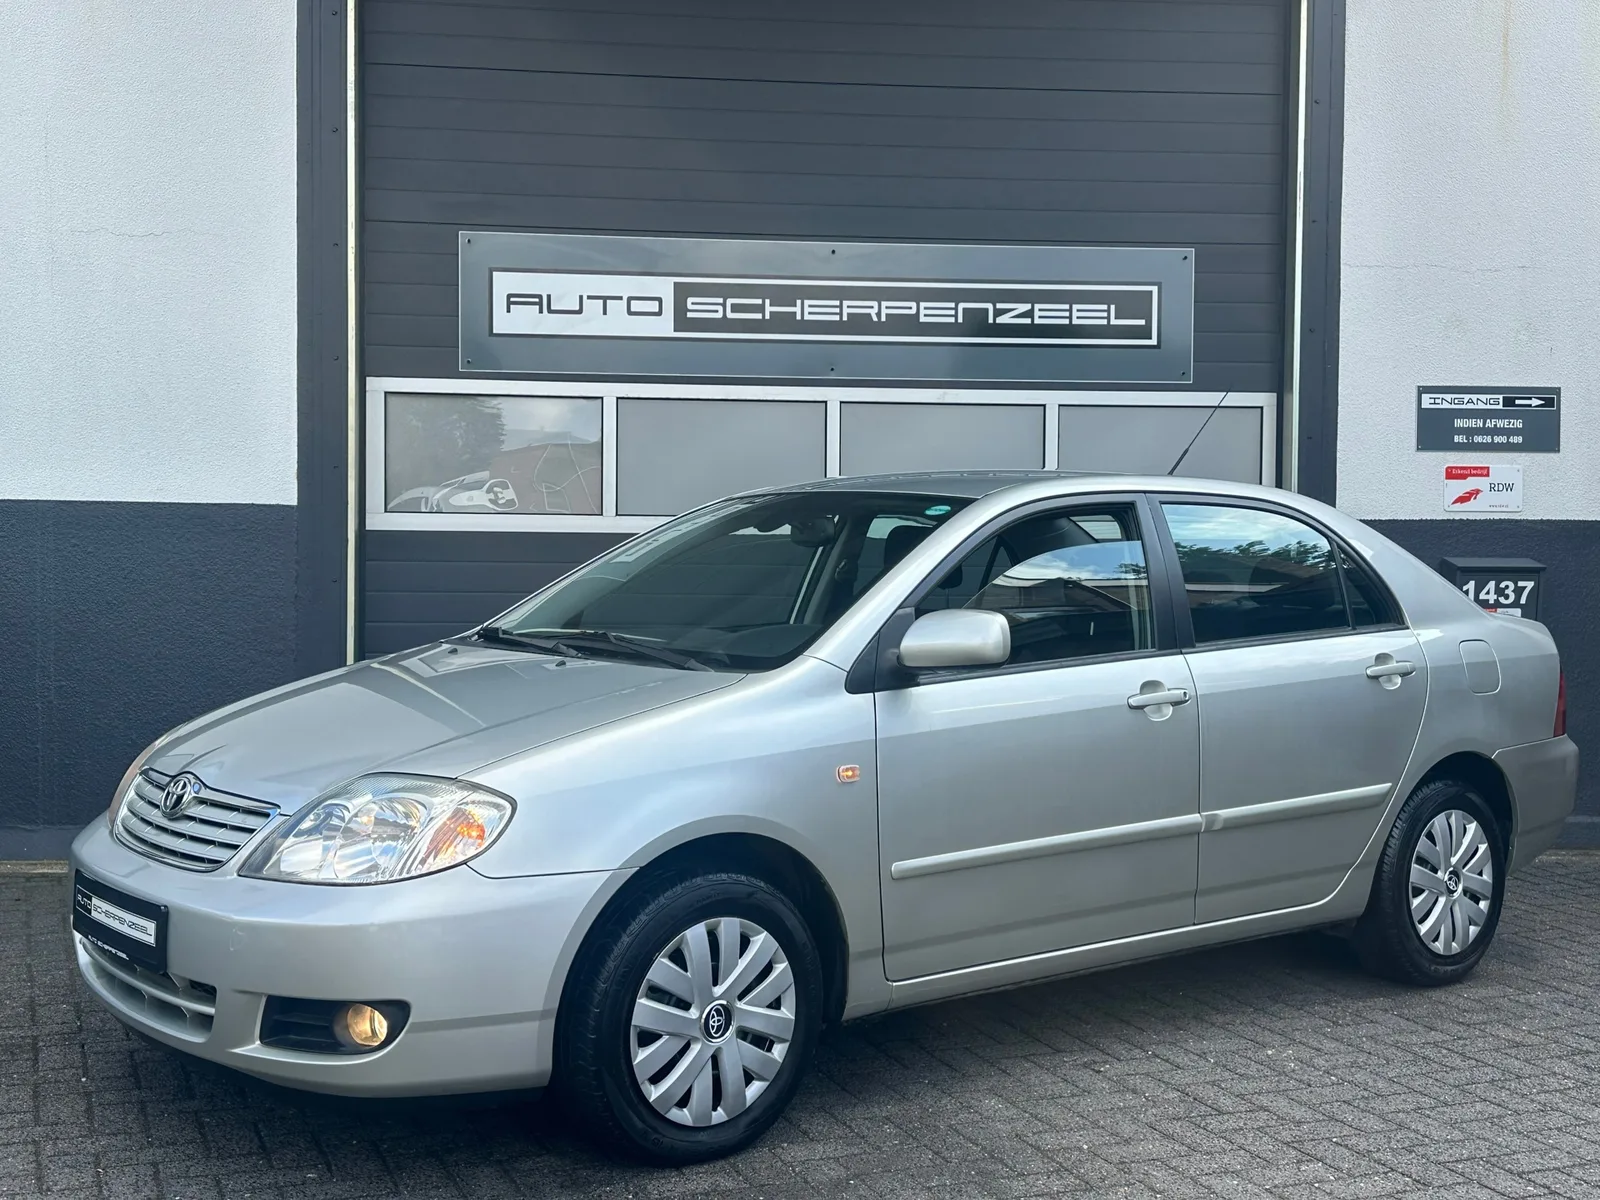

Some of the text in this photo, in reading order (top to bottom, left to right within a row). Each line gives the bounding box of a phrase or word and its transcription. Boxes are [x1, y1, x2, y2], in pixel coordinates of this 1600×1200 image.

[506, 293, 1146, 325] AUTO SCHERPENZEEL
[1429, 396, 1501, 406] INGANG
[1454, 418, 1523, 428] INDIEN AFWEZIG
[1454, 435, 1468, 443] BEL
[1473, 435, 1492, 443] 0626
[1493, 435, 1507, 444] 900
[1508, 435, 1523, 444] 489
[1489, 482, 1515, 492] RDW
[1462, 580, 1535, 605] 1437
[77, 893, 92, 909] AUTO
